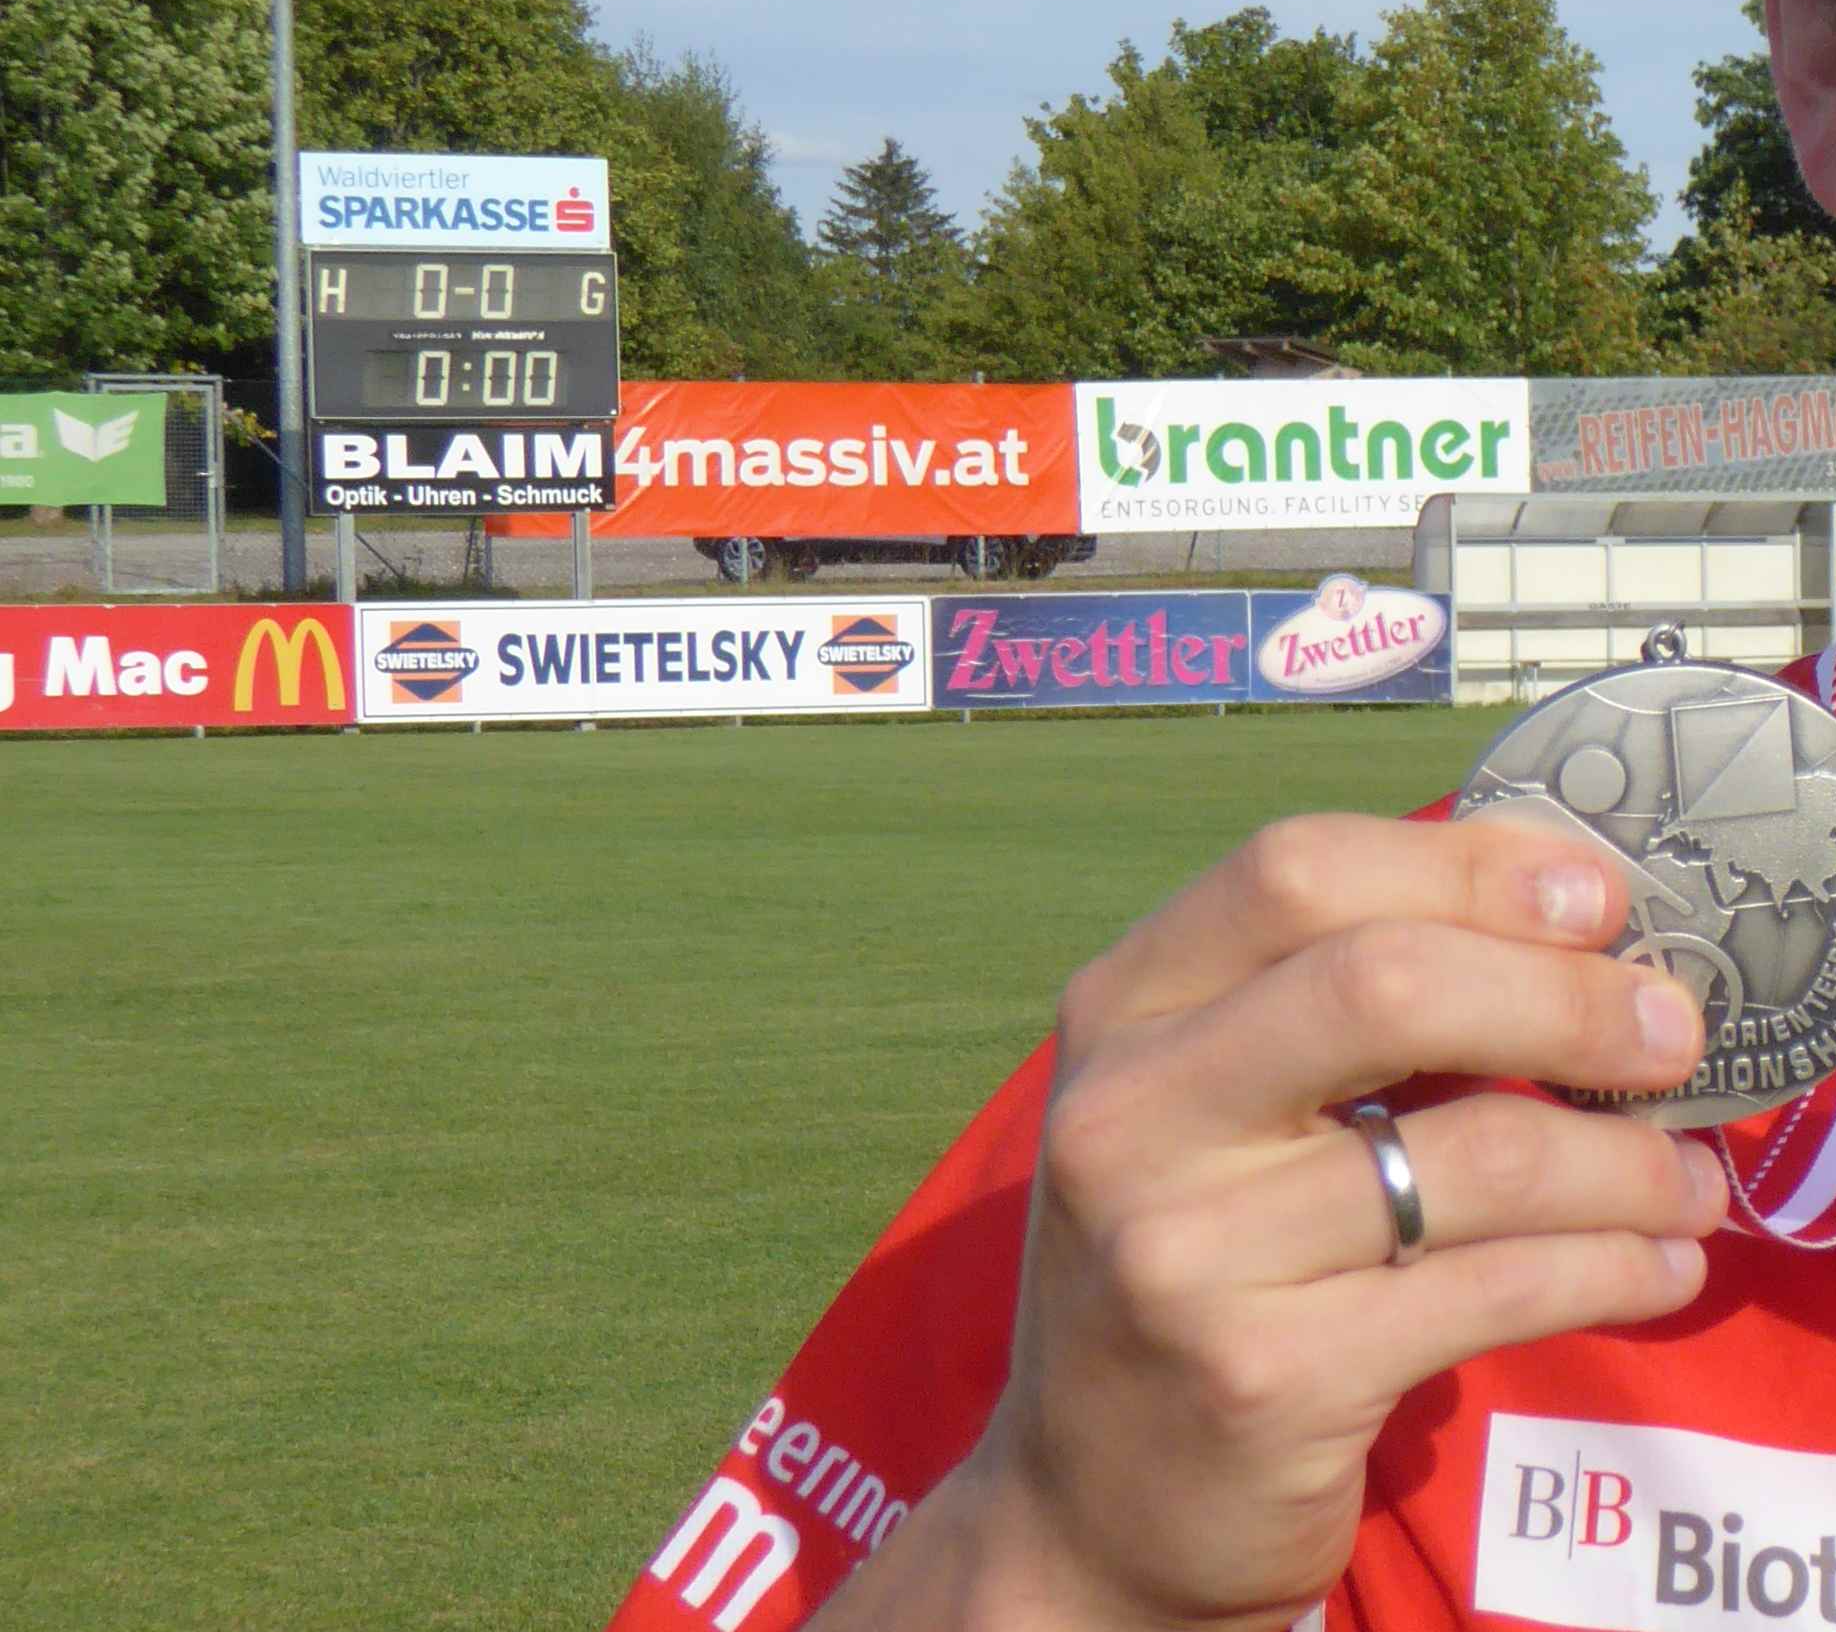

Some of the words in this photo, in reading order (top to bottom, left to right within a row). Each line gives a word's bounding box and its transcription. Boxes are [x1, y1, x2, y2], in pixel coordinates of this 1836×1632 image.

[318, 165, 470, 190] Waldviertler
[318, 195, 549, 232] SPARKASSE
[319, 270, 347, 313] H
[580, 272, 605, 314] G
[416, 351, 557, 406] 0:00
[323, 434, 603, 480] BLAIM
[614, 425, 1029, 488] 4massiv.at
[1096, 396, 1510, 487] brantner
[326, 484, 389, 508] Optik
[409, 486, 476, 506] Uhren
[497, 483, 603, 506] Schmuck
[1285, 495, 1391, 515] FACILITY
[45, 637, 209, 696] Mac
[377, 651, 475, 669] SWIETELSKY
[499, 630, 805, 686] SWIETELSKY
[819, 643, 914, 663] SWIETELSKY
[947, 609, 1247, 691] Zwettler
[1280, 612, 1425, 678] Zwettler
